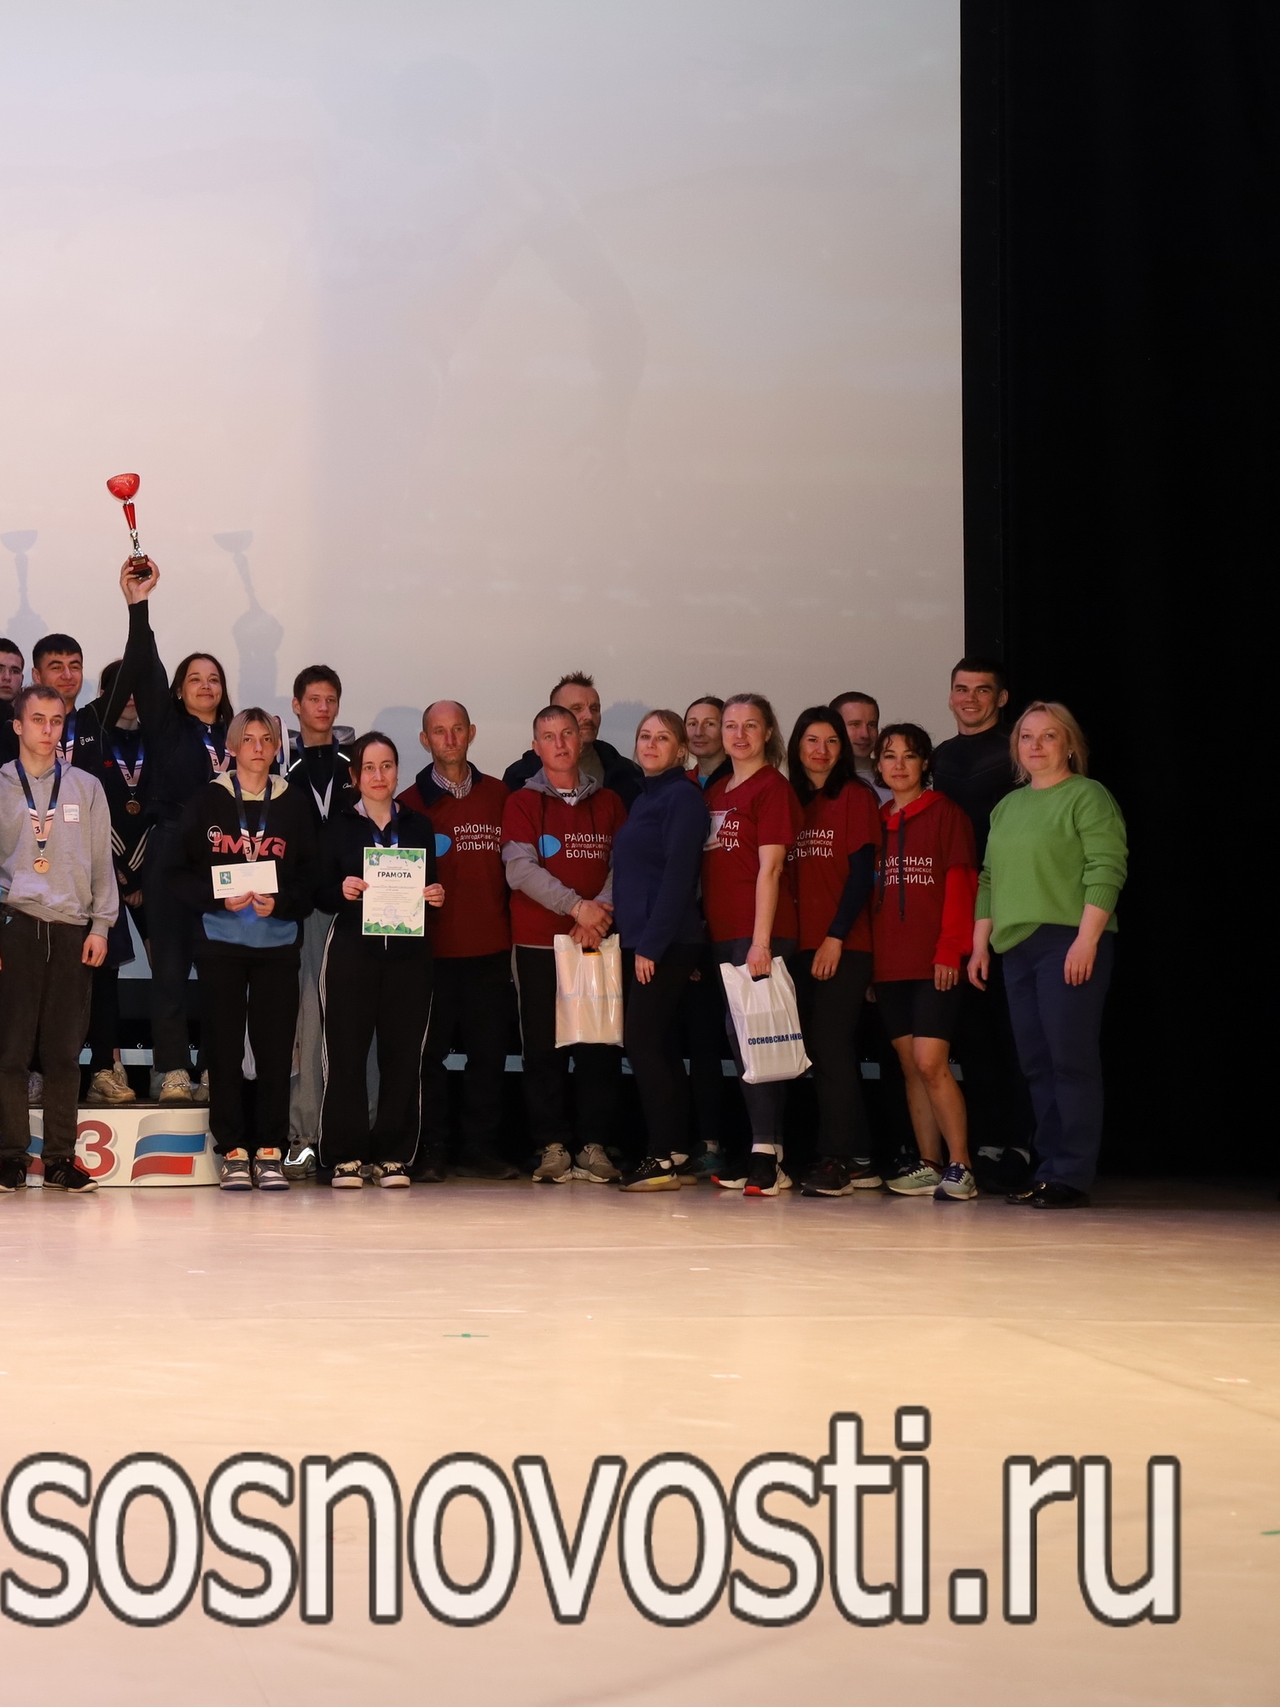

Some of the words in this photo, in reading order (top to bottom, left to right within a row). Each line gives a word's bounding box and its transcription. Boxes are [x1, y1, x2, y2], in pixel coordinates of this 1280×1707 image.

[125, 773, 131, 781] 3
[34, 826, 41, 834] 3
[797, 829, 834, 840] ОННАЯ
[245, 846, 251, 854] 3
[377, 871, 412, 879] ГРАМОТА
[747, 1034, 790, 1046] СОСНОВСКАЯ
[789, 1033, 803, 1042] НИВ
[73, 1120, 117, 1178] 3
